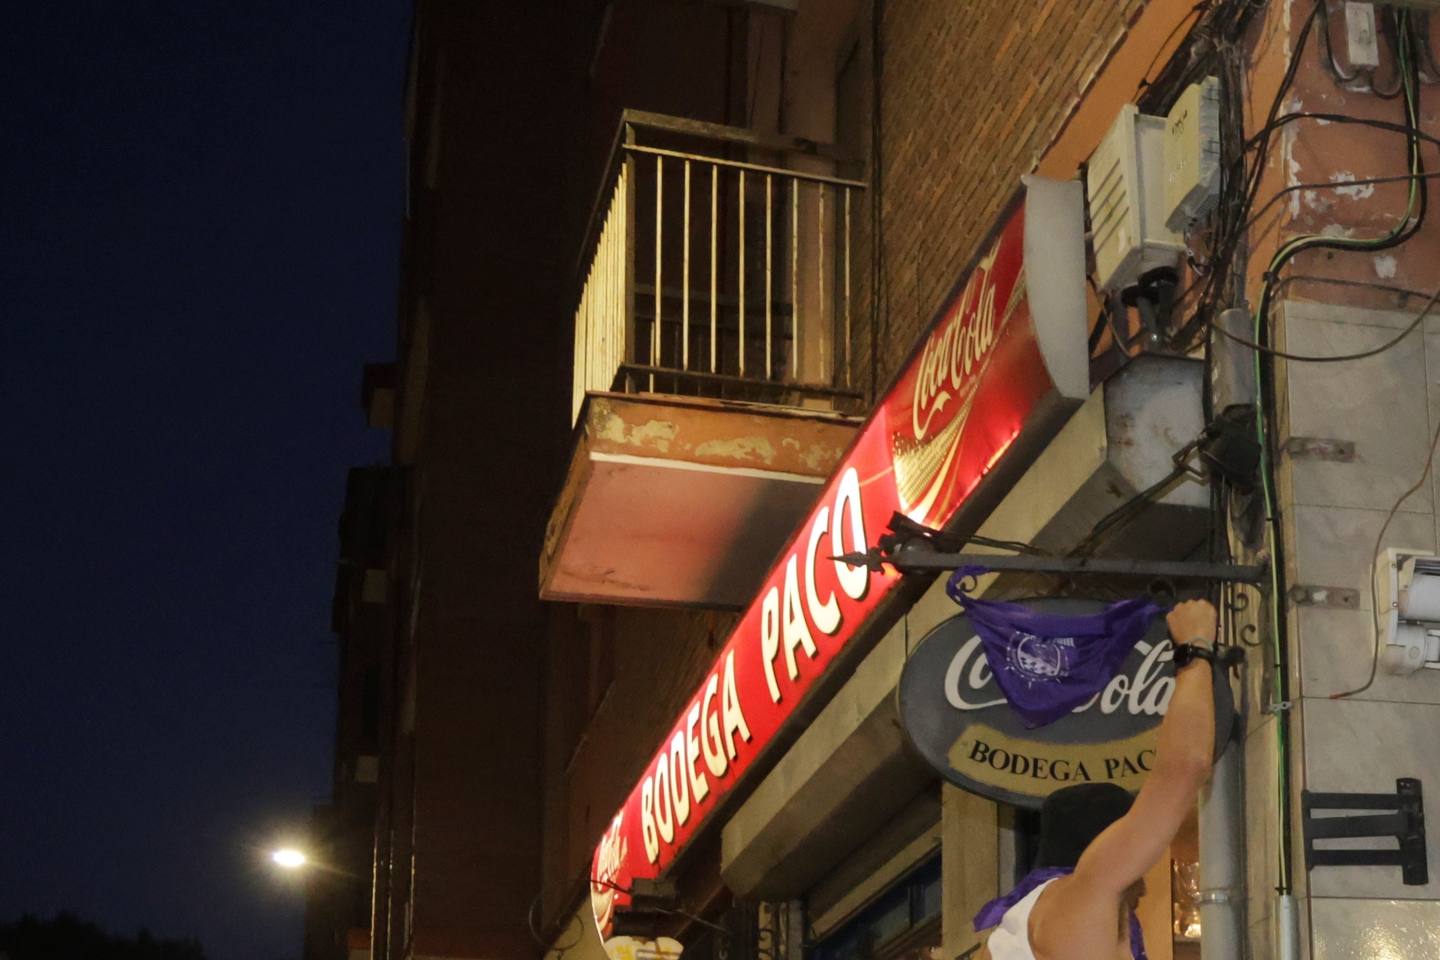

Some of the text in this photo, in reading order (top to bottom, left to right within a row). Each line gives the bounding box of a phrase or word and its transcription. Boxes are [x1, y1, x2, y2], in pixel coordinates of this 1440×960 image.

[641, 466, 869, 864] BODEGA PACO
[968, 740, 1156, 781] BODEGA PAC
